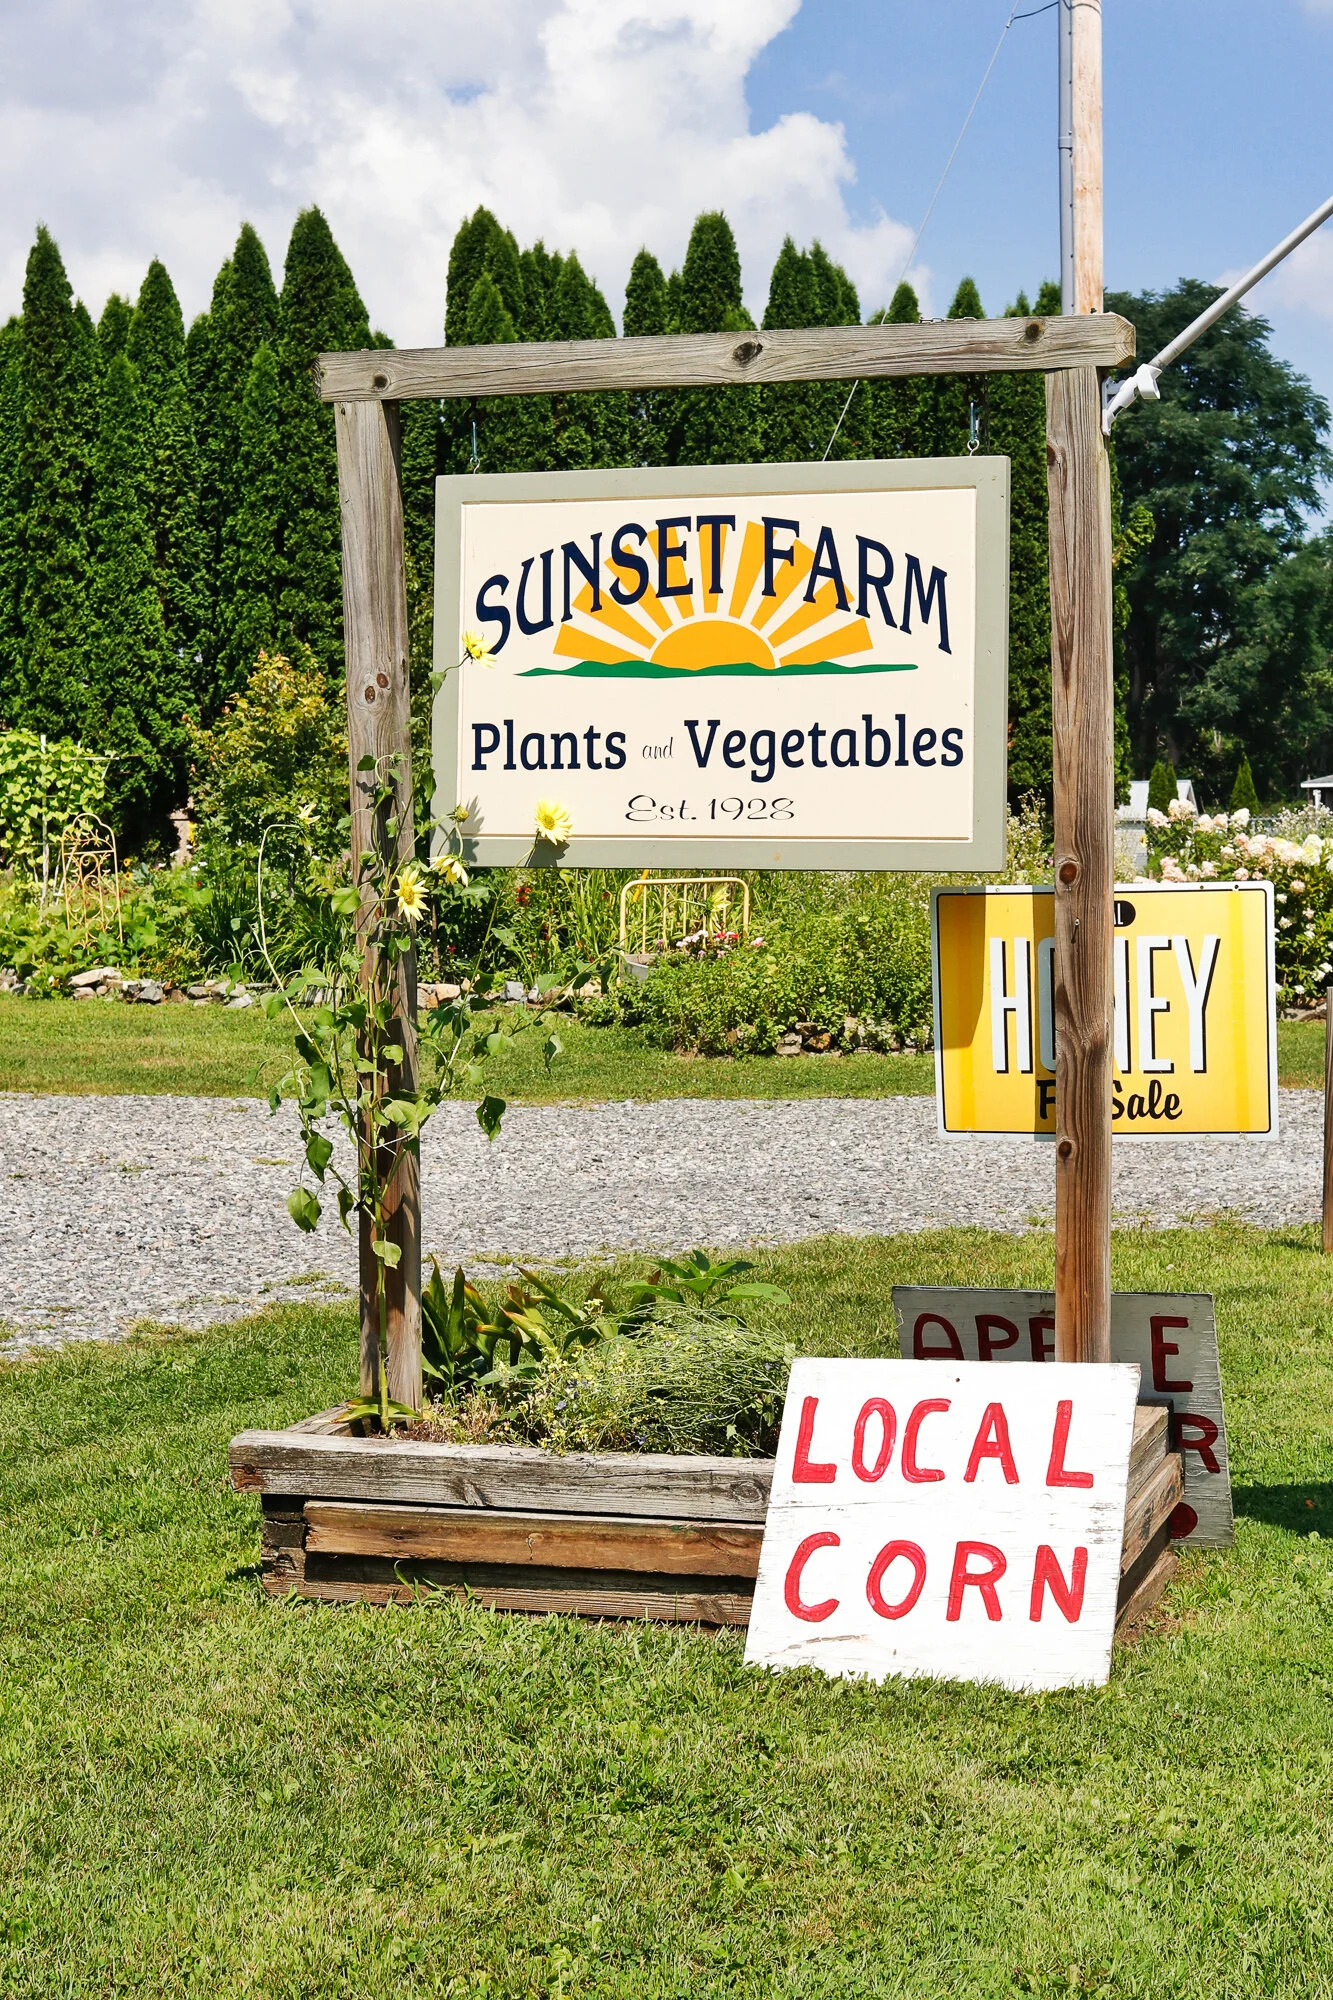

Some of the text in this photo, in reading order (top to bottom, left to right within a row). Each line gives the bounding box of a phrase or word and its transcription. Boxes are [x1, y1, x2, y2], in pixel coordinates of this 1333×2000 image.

[475, 514, 952, 656] SUNSET FARM
[471, 713, 965, 783] Plants and Vegetables
[624, 794, 796, 823] Est. 1928
[791, 1395, 1095, 1489] LOCAL
[784, 1531, 1089, 1624] CORN
